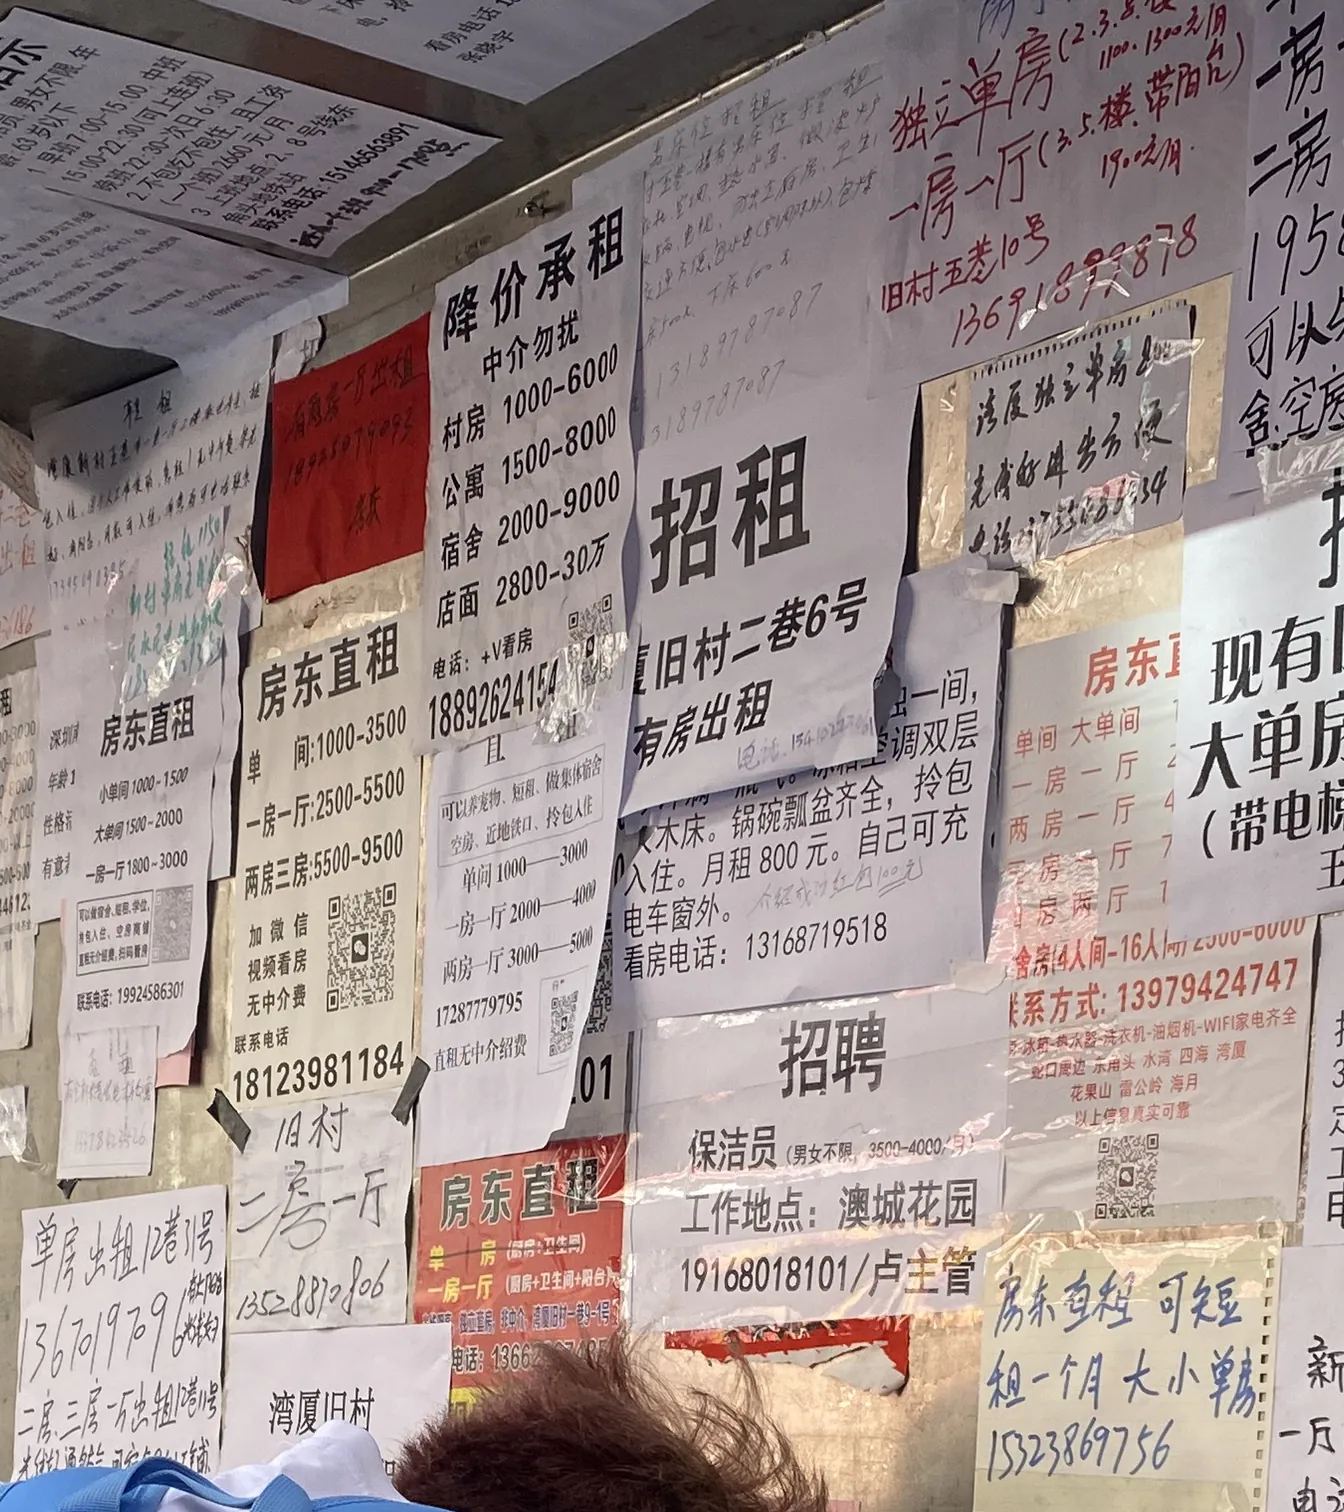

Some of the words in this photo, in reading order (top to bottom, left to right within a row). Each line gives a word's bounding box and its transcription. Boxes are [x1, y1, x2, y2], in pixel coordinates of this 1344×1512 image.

[889, 25, 1054, 157] 独立单房
[889, 130, 1036, 241] 一房一厅
[442, 205, 624, 352] 降价承租
[881, 213, 1051, 314] 旧村五巷10号
[483, 309, 579, 383] 中介勿扰
[442, 403, 486, 453] 村房
[503, 343, 618, 425] 1000-6000
[442, 464, 485, 511] 公寓
[502, 406, 617, 485] 1500-8000
[441, 524, 484, 571] 宿舍
[498, 470, 621, 547] 2000-9000
[650, 436, 810, 594] 招租
[437, 582, 479, 629] 店面
[496, 532, 610, 608] 2800-30万
[257, 621, 398, 722] 房东直租
[100, 695, 195, 757] 房东直租
[634, 679, 773, 771] 有房出租
[1071, 706, 1141, 747] 大单间
[247, 948, 307, 983] 视频看房
[249, 912, 309, 948] 加微信
[247, 985, 306, 1018] 无中介费
[435, 991, 523, 1028] 17287779795
[234, 1041, 404, 1103] 18123981184
[235, 1026, 289, 1055] 联系电话
[778, 1010, 887, 1099] 招聘
[688, 1125, 777, 1172] 保洁员
[440, 1157, 600, 1232] 房东直租
[428, 1273, 493, 1304] 一房一厅
[681, 1245, 977, 1297] 19168018101/卢主管
[270, 1387, 375, 1436] 湾厦旧村
[988, 1418, 1174, 1482] 15323869756
